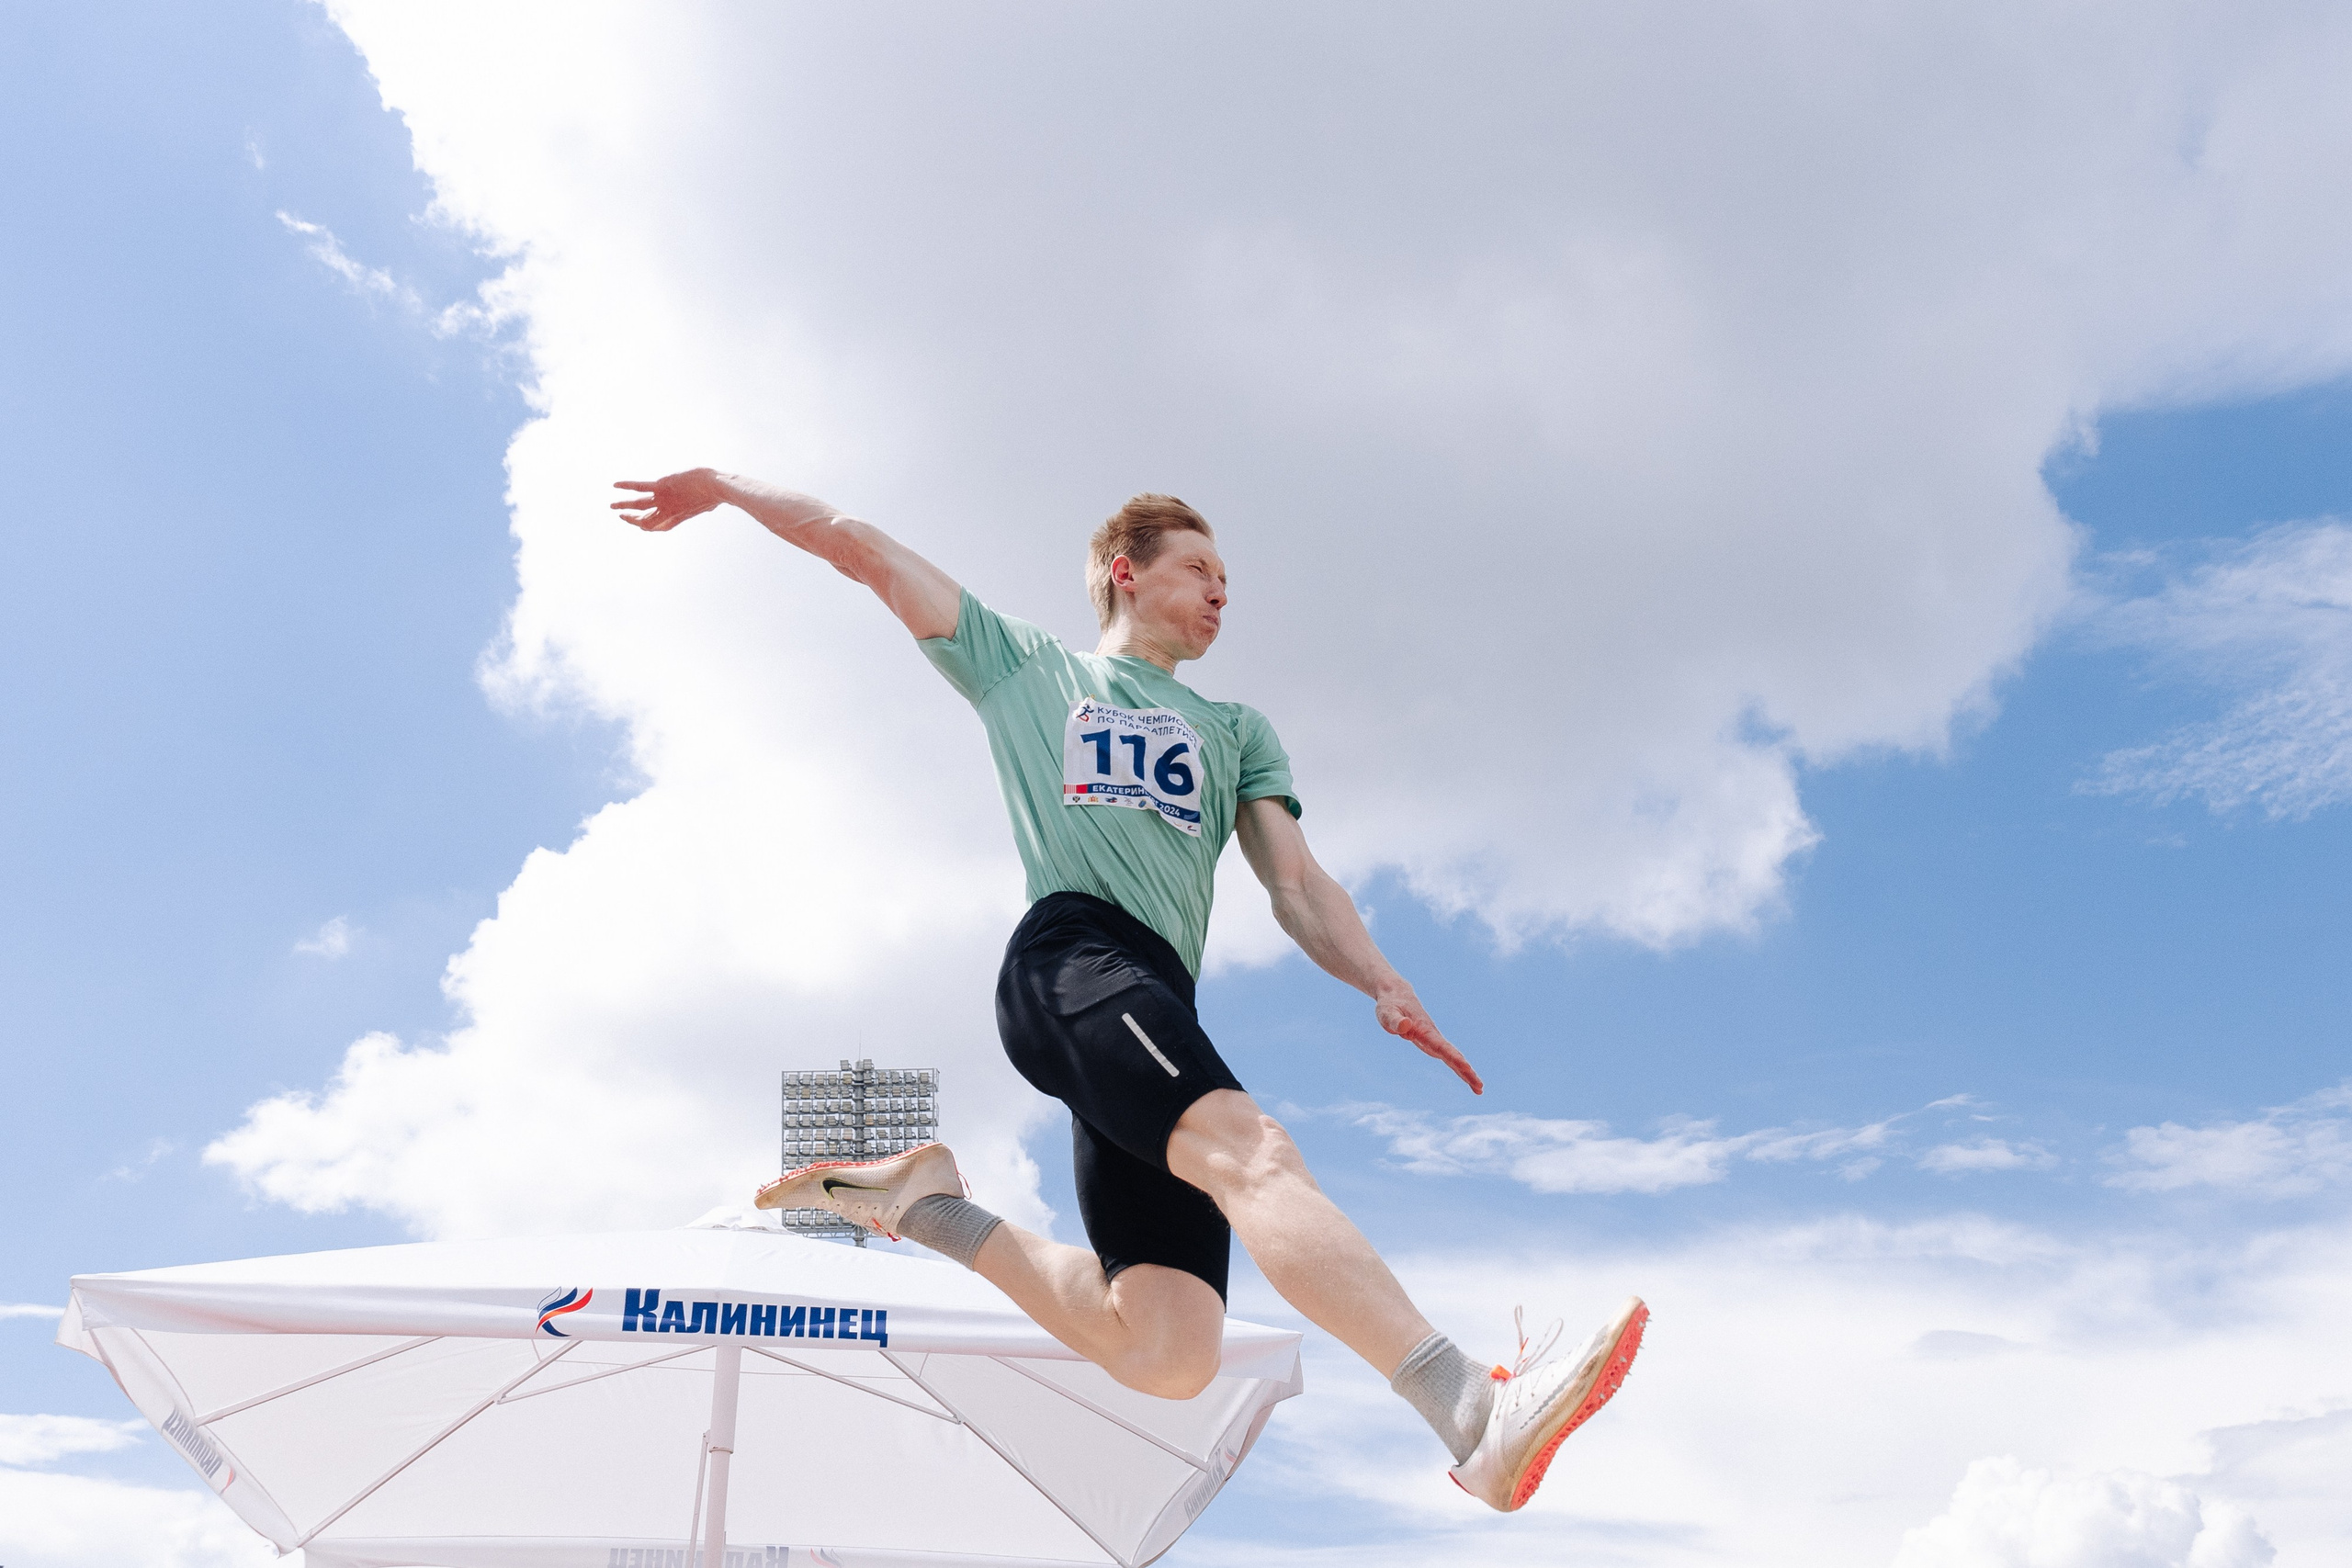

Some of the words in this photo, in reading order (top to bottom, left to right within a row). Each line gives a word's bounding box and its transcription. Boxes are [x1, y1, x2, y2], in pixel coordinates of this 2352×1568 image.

[1097, 706, 1135, 721] КУБОК
[1097, 716, 1115, 724] ПО
[1080, 728, 1194, 796] 116
[1159, 804, 1181, 817] 2024
